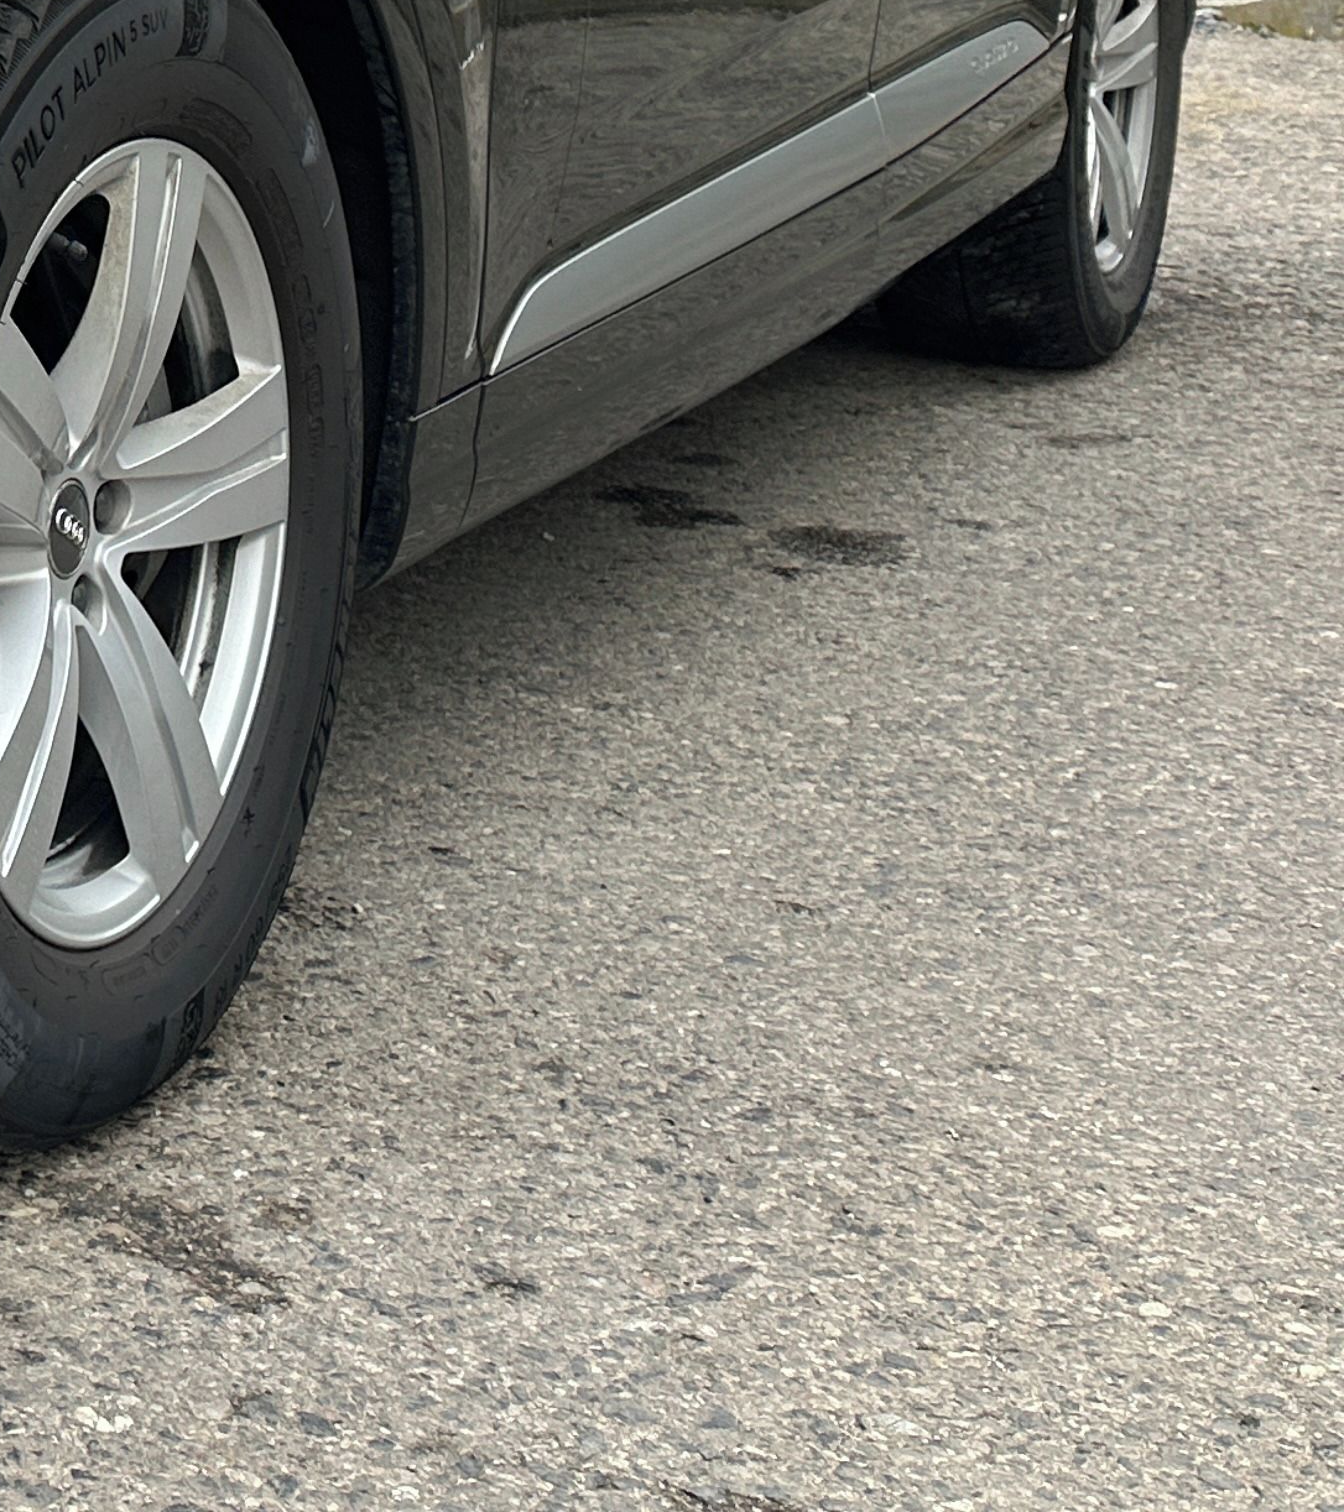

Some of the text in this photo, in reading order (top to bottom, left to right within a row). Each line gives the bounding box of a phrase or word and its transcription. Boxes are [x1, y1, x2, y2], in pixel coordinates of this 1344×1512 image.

[12, 86, 64, 188] PILOT
[73, 27, 127, 104] ALPIN
[141, 7, 169, 37] SUV
